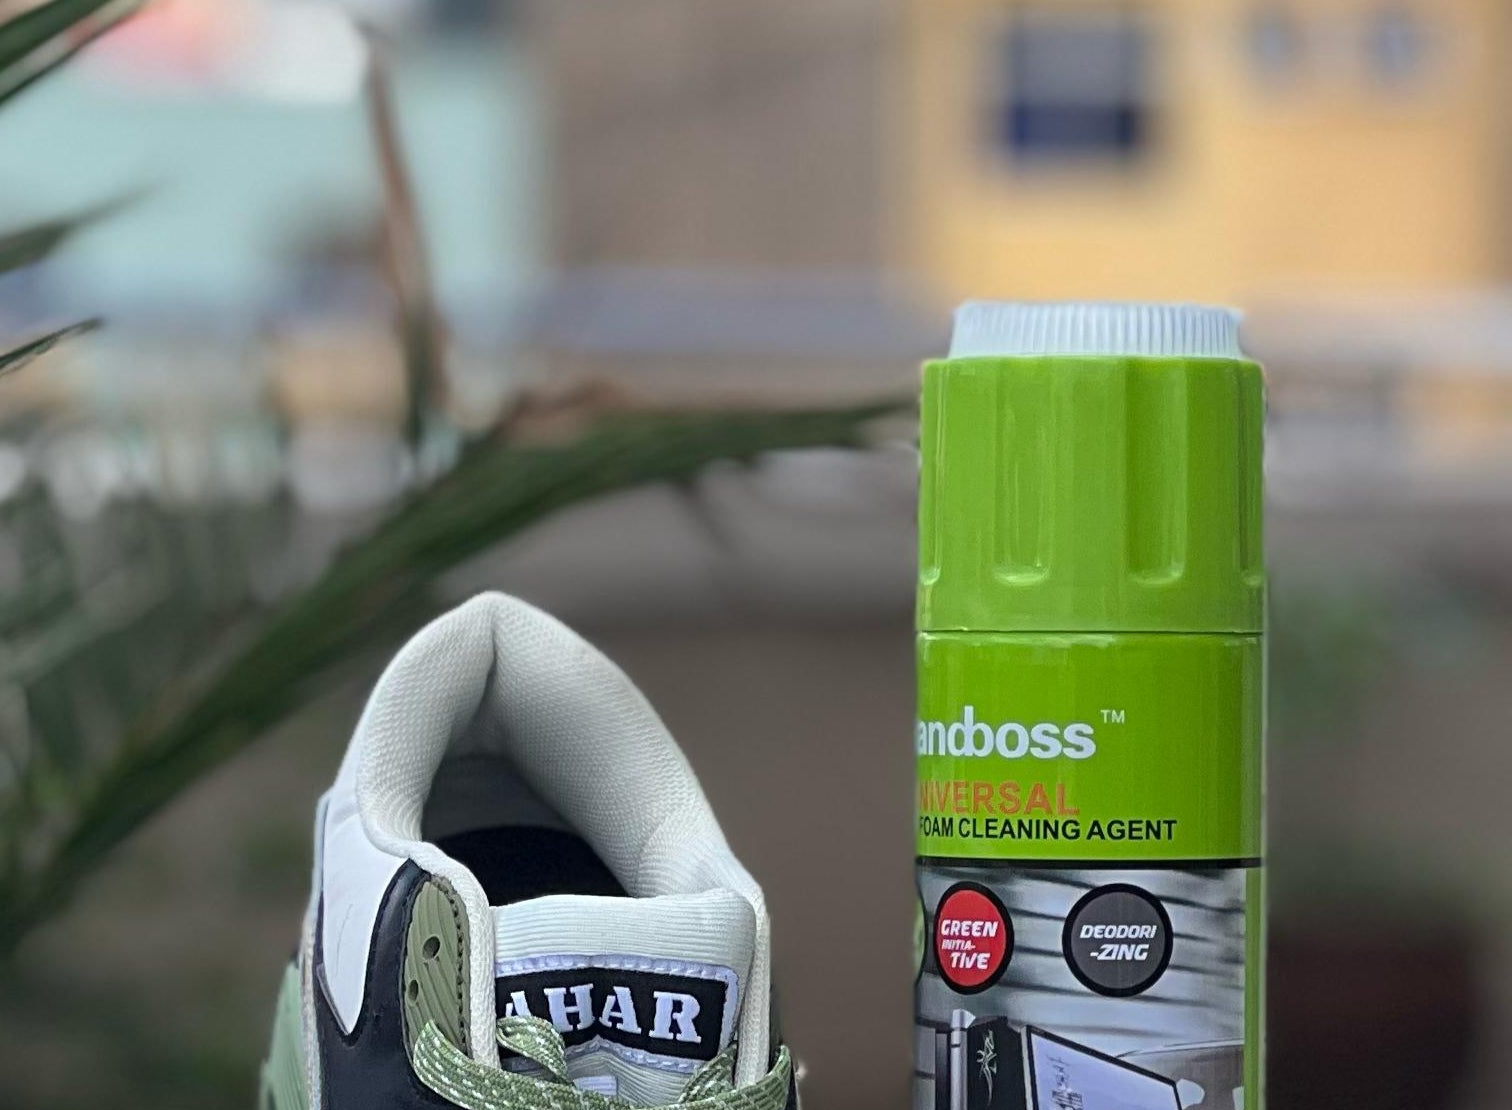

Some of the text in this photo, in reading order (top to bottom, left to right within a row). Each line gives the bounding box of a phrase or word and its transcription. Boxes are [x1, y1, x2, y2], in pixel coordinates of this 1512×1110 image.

[1100, 709, 1126, 724] TM
[958, 818, 1081, 840] CLEANING
[1087, 819, 1177, 841] AGENT
[941, 919, 999, 938] GREEN
[1079, 924, 1157, 939] DEODORI
